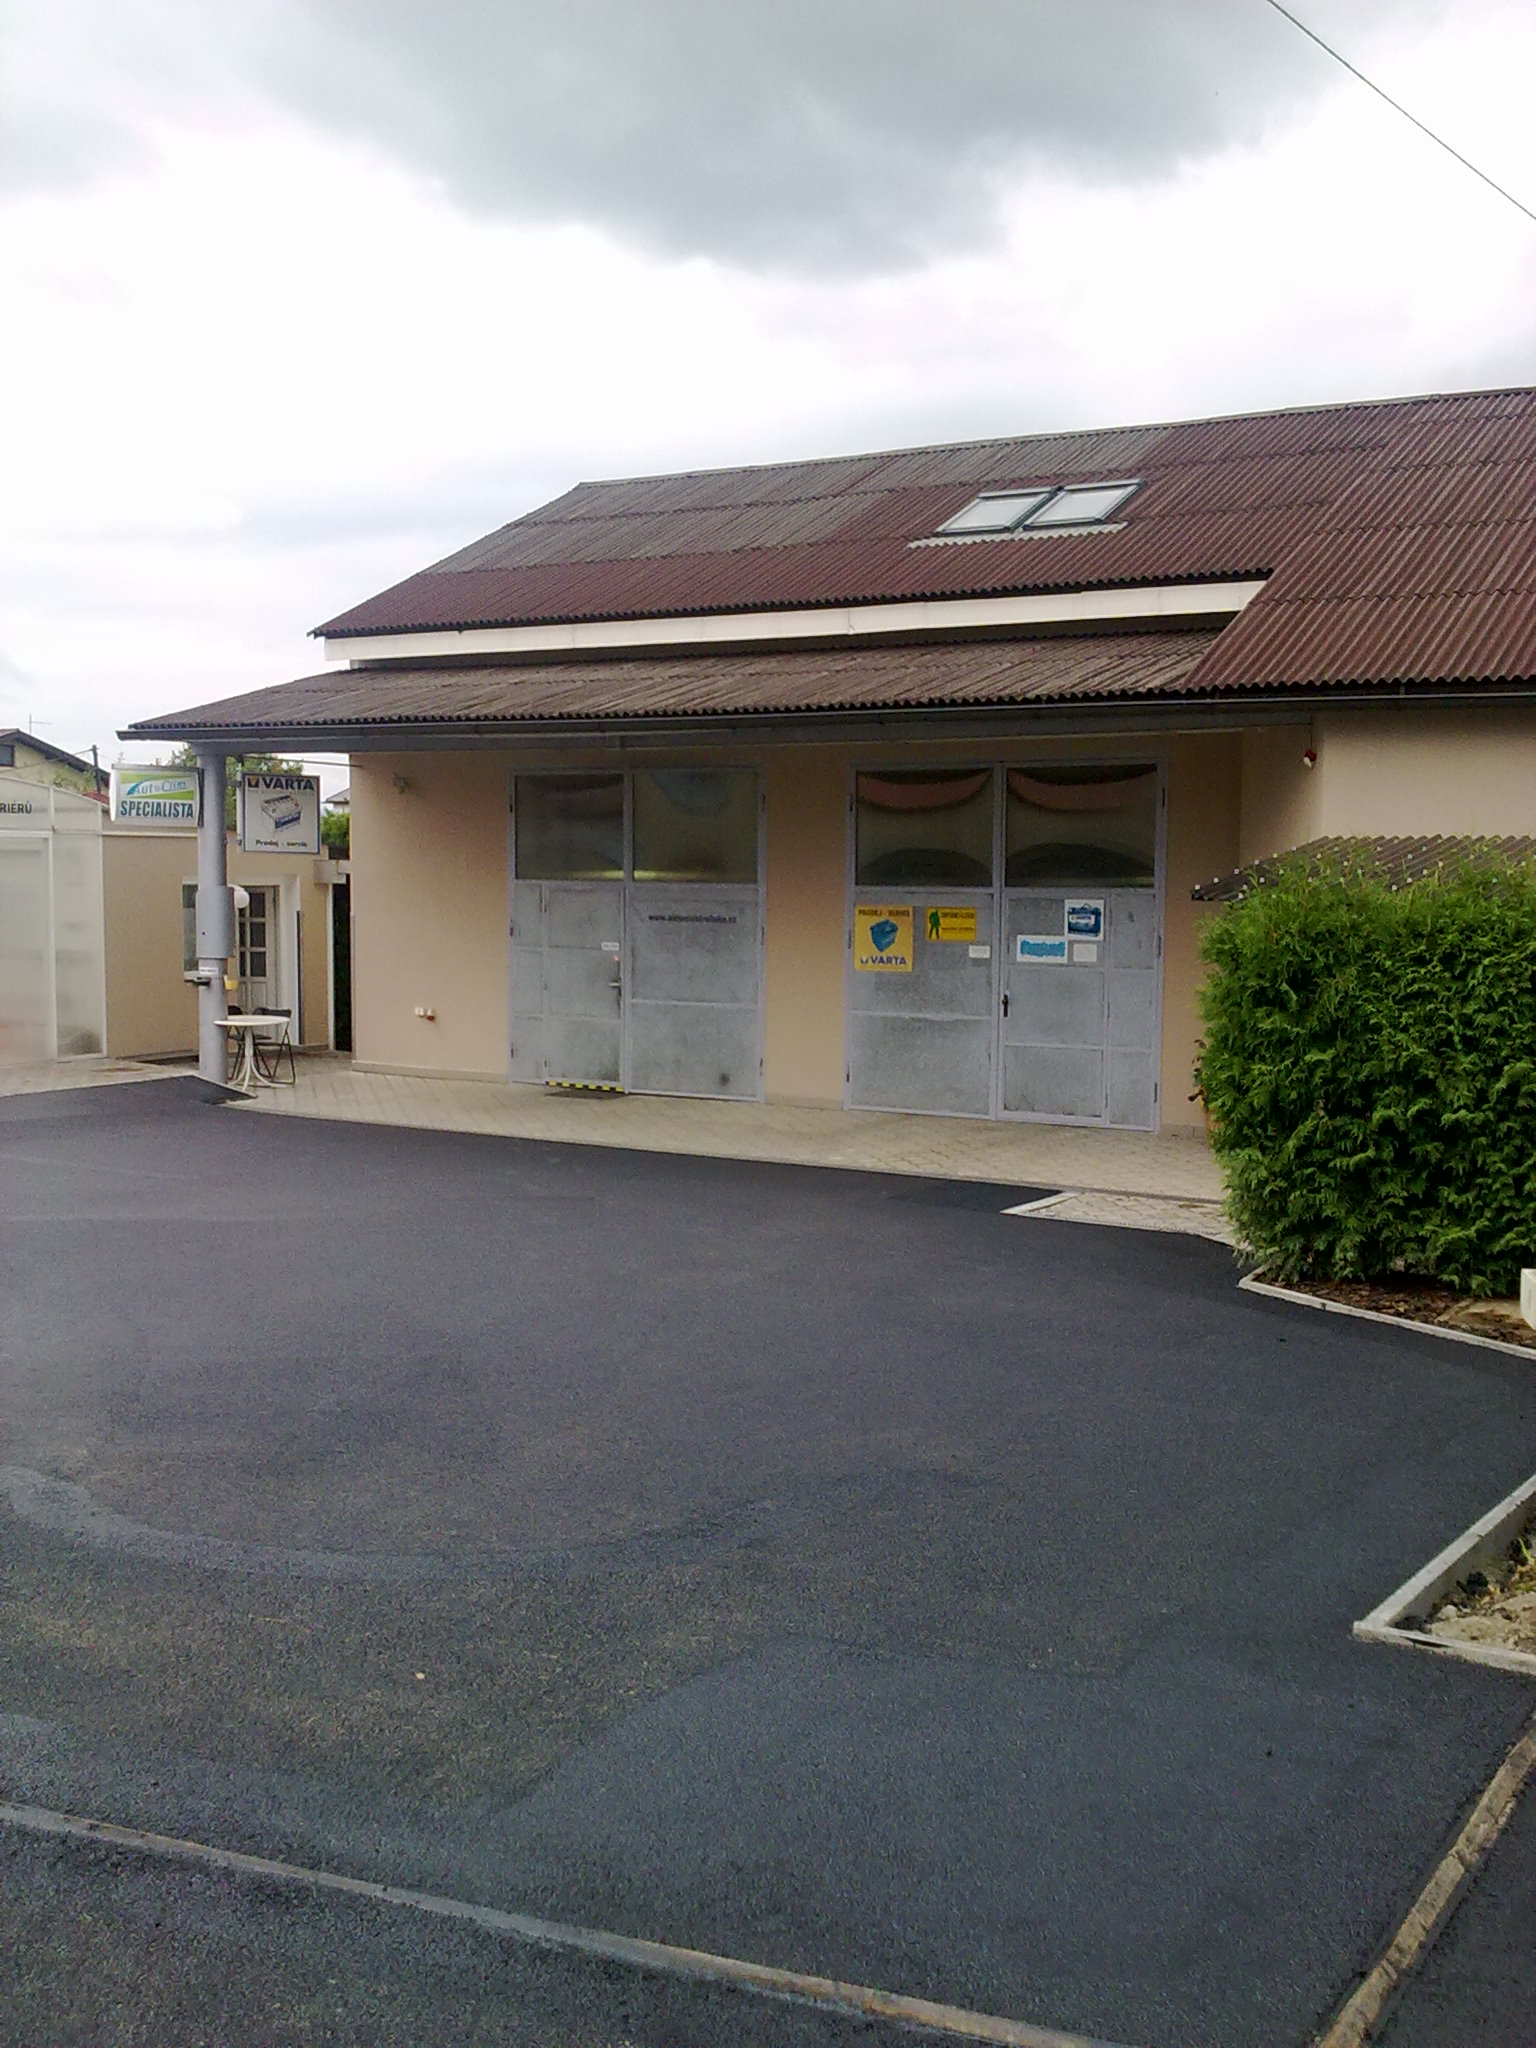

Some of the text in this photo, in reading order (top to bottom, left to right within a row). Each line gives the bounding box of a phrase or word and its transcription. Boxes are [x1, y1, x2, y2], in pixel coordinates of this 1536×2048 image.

[262, 776, 315, 791] VARTA
[120, 800, 194, 818] SPECIALISTA
[870, 955, 907, 966] VARTA
